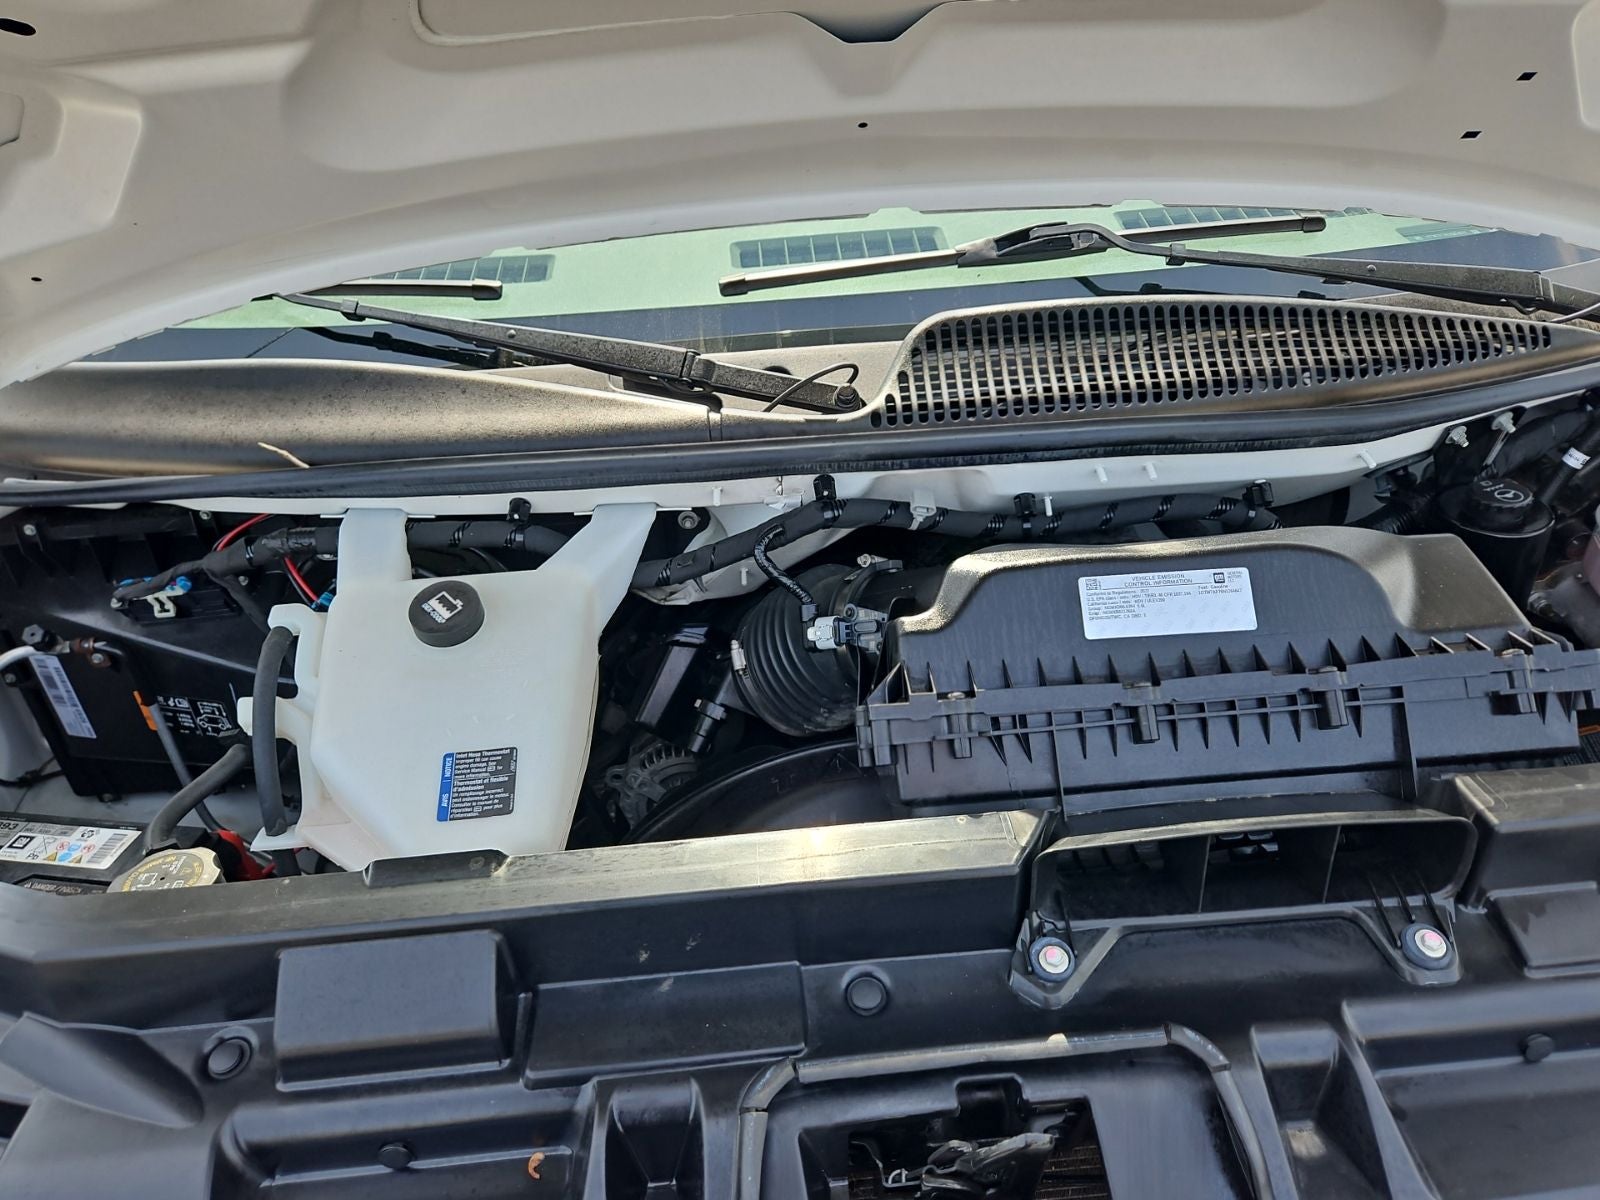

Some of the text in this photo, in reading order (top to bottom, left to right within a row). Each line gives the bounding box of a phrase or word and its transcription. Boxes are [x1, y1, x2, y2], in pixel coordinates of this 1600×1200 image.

[444, 757, 453, 778] NOTICE
[454, 779, 483, 787] Thermostat
[441, 793, 449, 807] AVIS
